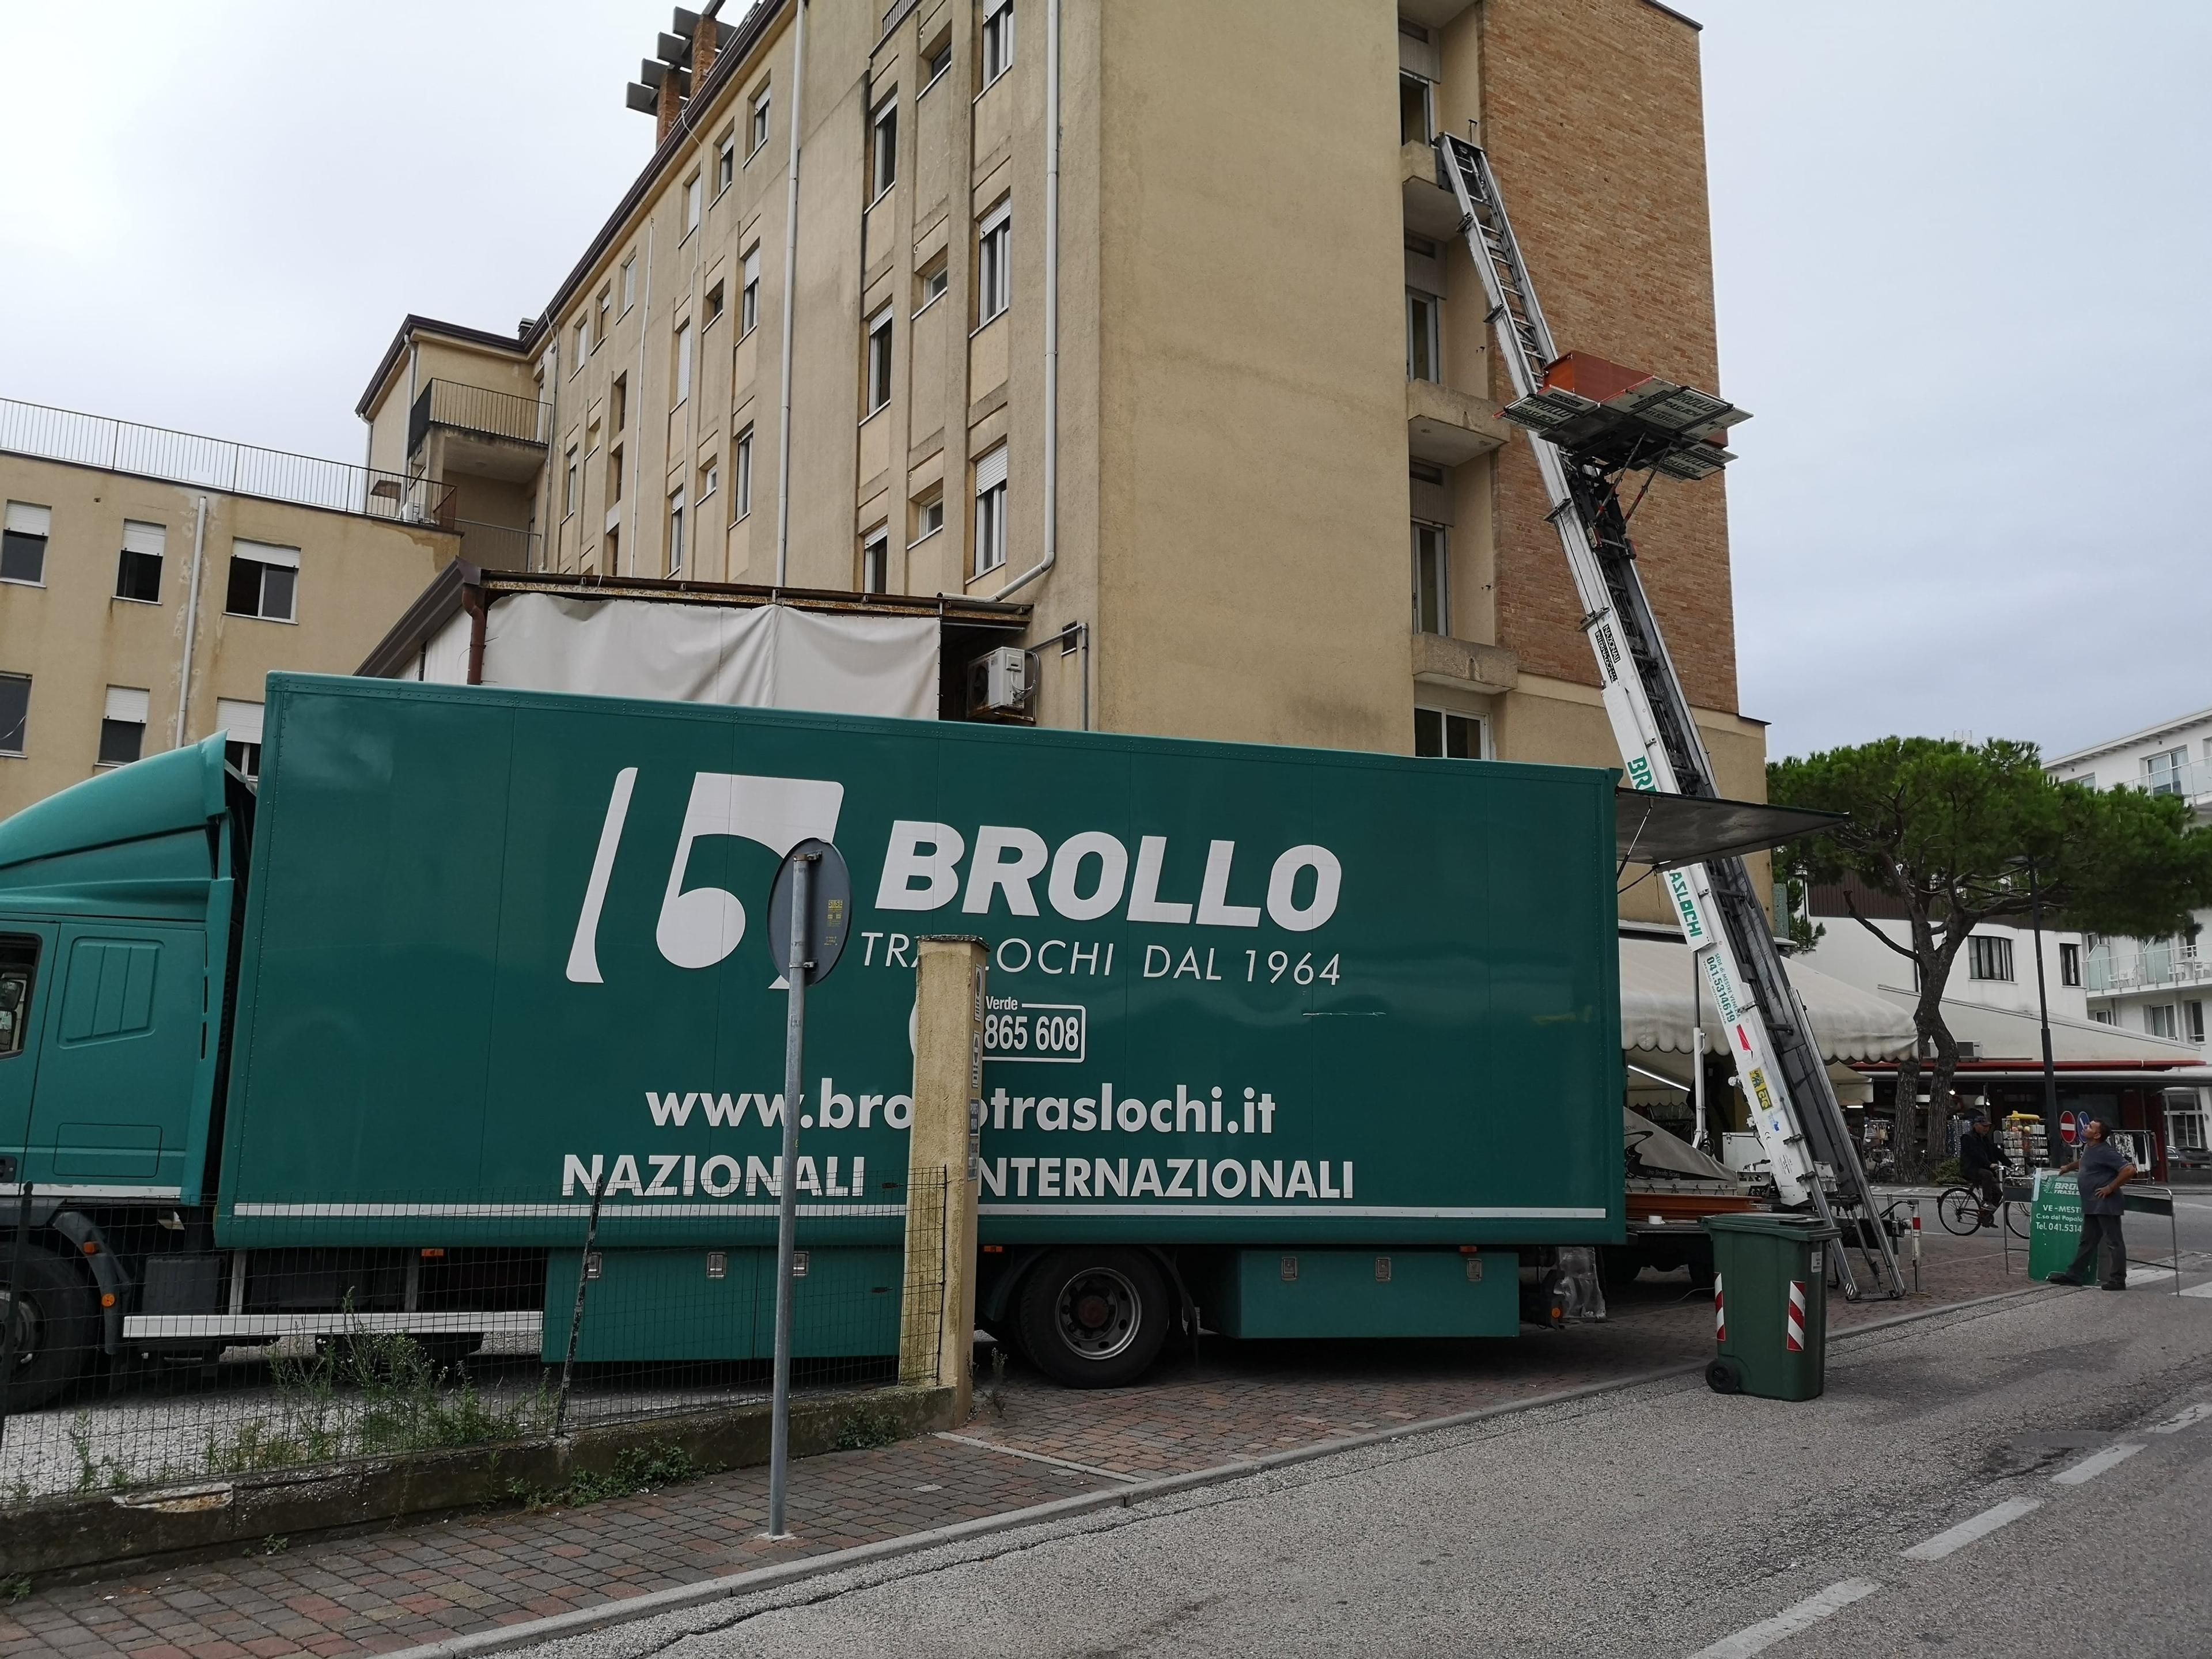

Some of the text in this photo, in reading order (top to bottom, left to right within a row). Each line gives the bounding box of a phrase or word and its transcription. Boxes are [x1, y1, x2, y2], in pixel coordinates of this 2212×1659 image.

[1603, 625, 1620, 662] NAZIONALI
[875, 820, 1341, 931] BROLLO
[1669, 871, 1703, 938] ASLOCHI
[862, 933, 1339, 986] TROCHI DAL 1964
[986, 995, 1018, 1010] Verde
[1707, 956, 1736, 1023] 041.5314619
[1722, 974, 1733, 994] MESTRE
[984, 1014, 1079, 1051] 865 608
[646, 1078, 1275, 1133] www.brotraslochi.it
[562, 1154, 865, 1196] NAZIONALI
[978, 1157, 1353, 1198] NTERNAZIONALI
[2036, 1222, 2082, 1232] Tel. 041.5314
[2059, 1206, 2081, 1214] MEST
